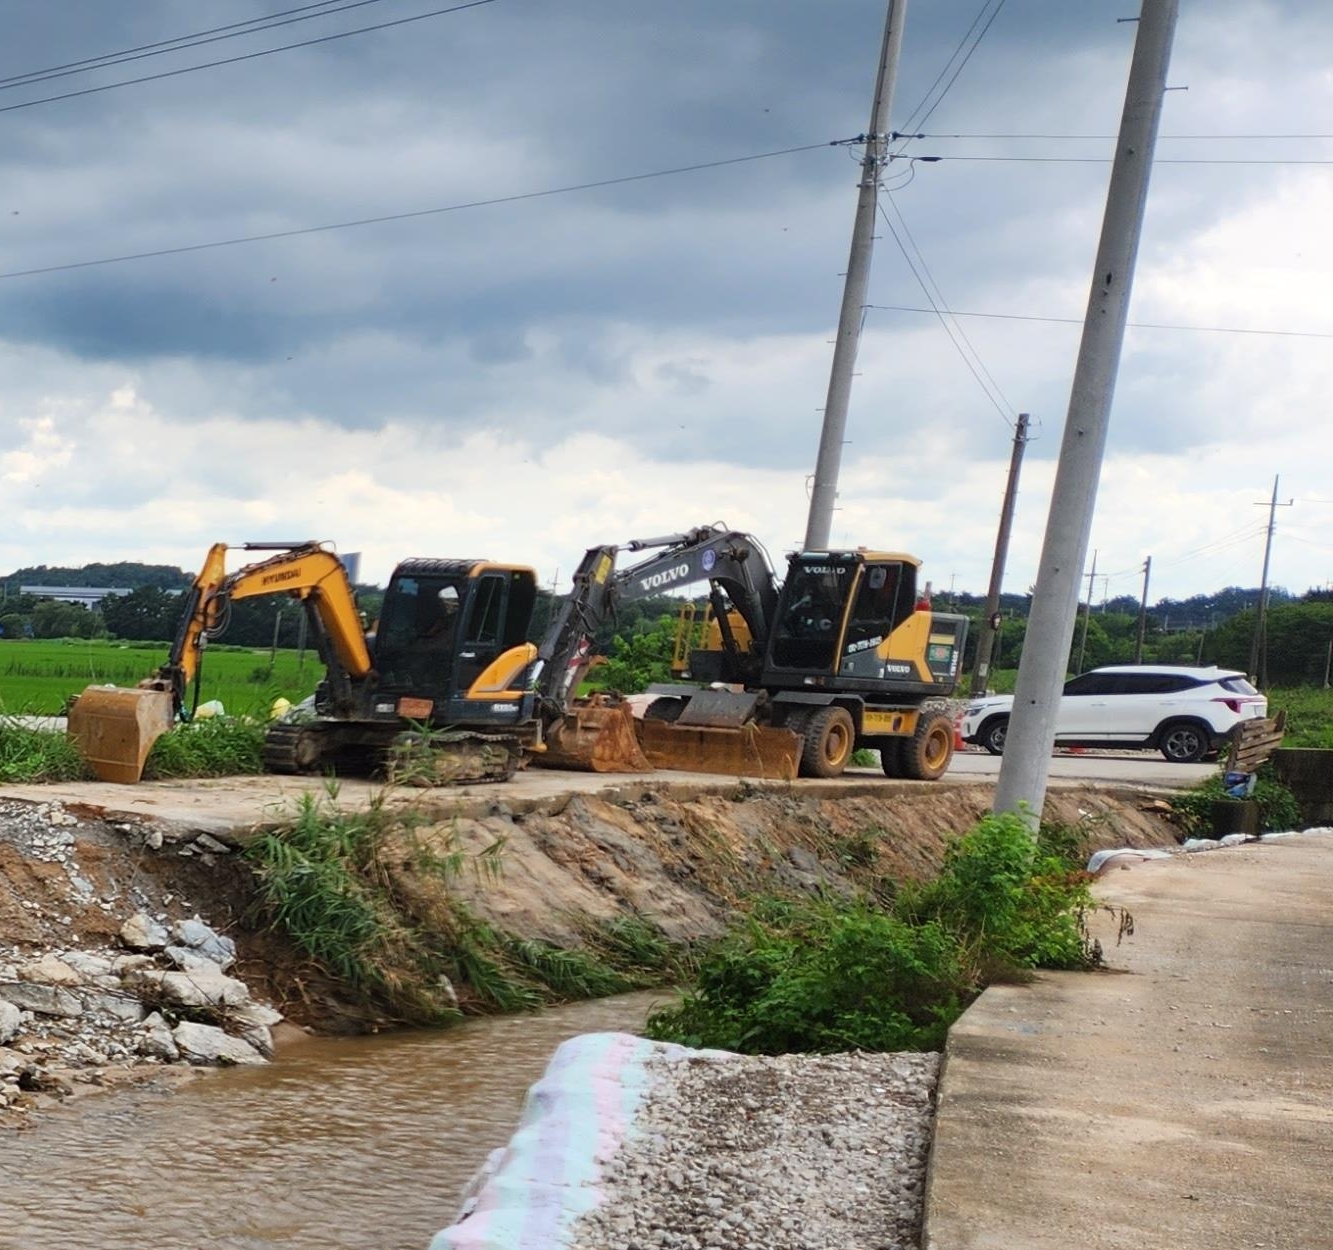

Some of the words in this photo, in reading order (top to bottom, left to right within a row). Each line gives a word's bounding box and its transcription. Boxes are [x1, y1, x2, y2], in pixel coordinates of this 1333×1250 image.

[261, 567, 302, 587] HYUNDAI
[640, 563, 689, 590] VOLVO
[886, 664, 911, 673] VOLVO
